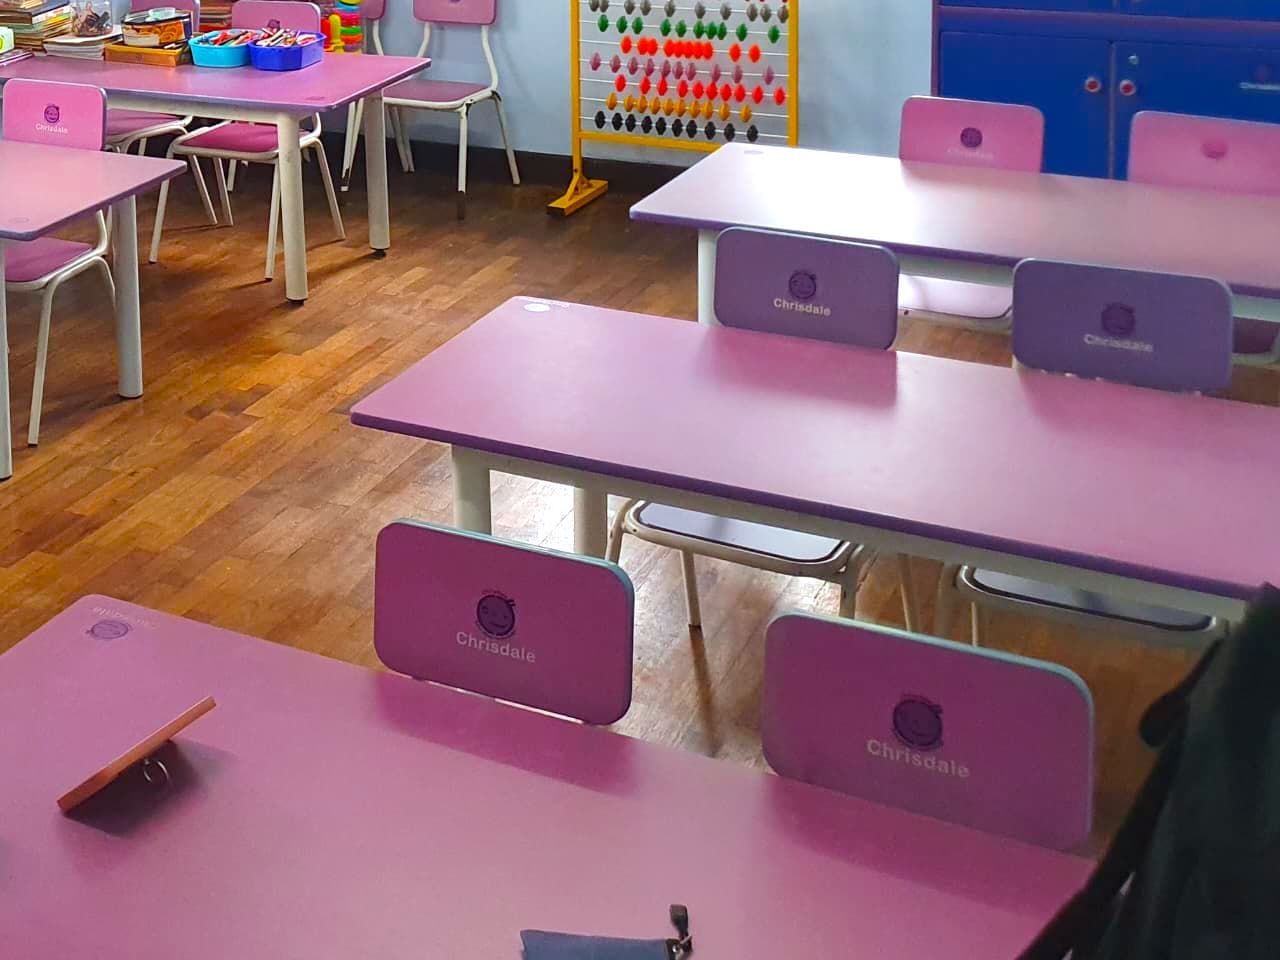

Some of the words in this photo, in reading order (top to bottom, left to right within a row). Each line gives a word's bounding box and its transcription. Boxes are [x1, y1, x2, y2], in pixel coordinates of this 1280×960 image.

[772, 297, 831, 318] Chrisdale
[456, 631, 537, 663] Chrisdale
[866, 739, 970, 778] Chrisdale
